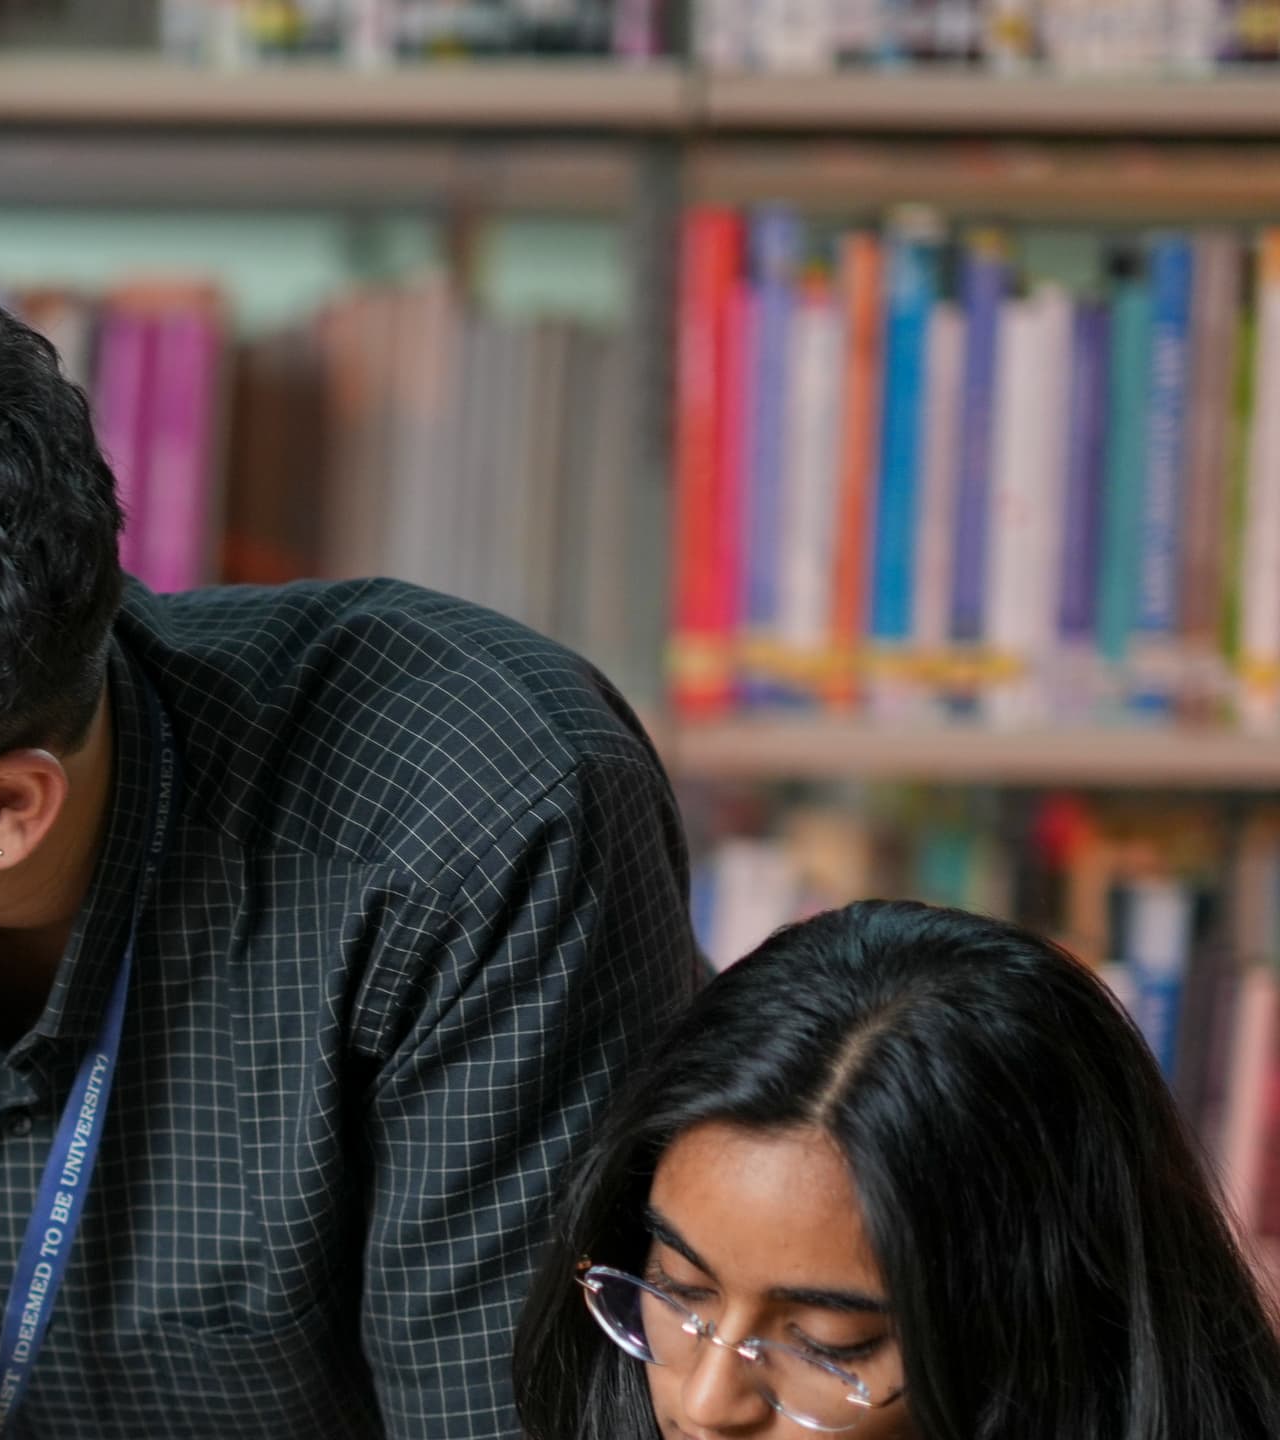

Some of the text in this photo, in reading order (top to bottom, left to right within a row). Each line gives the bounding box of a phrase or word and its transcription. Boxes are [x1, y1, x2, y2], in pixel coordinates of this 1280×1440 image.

[60, 1053, 110, 1187] UNIVERSITY)
[40, 1227, 64, 1257] TO
[49, 1191, 74, 1225] BE
[12, 1261, 53, 1364] (DEEMED
